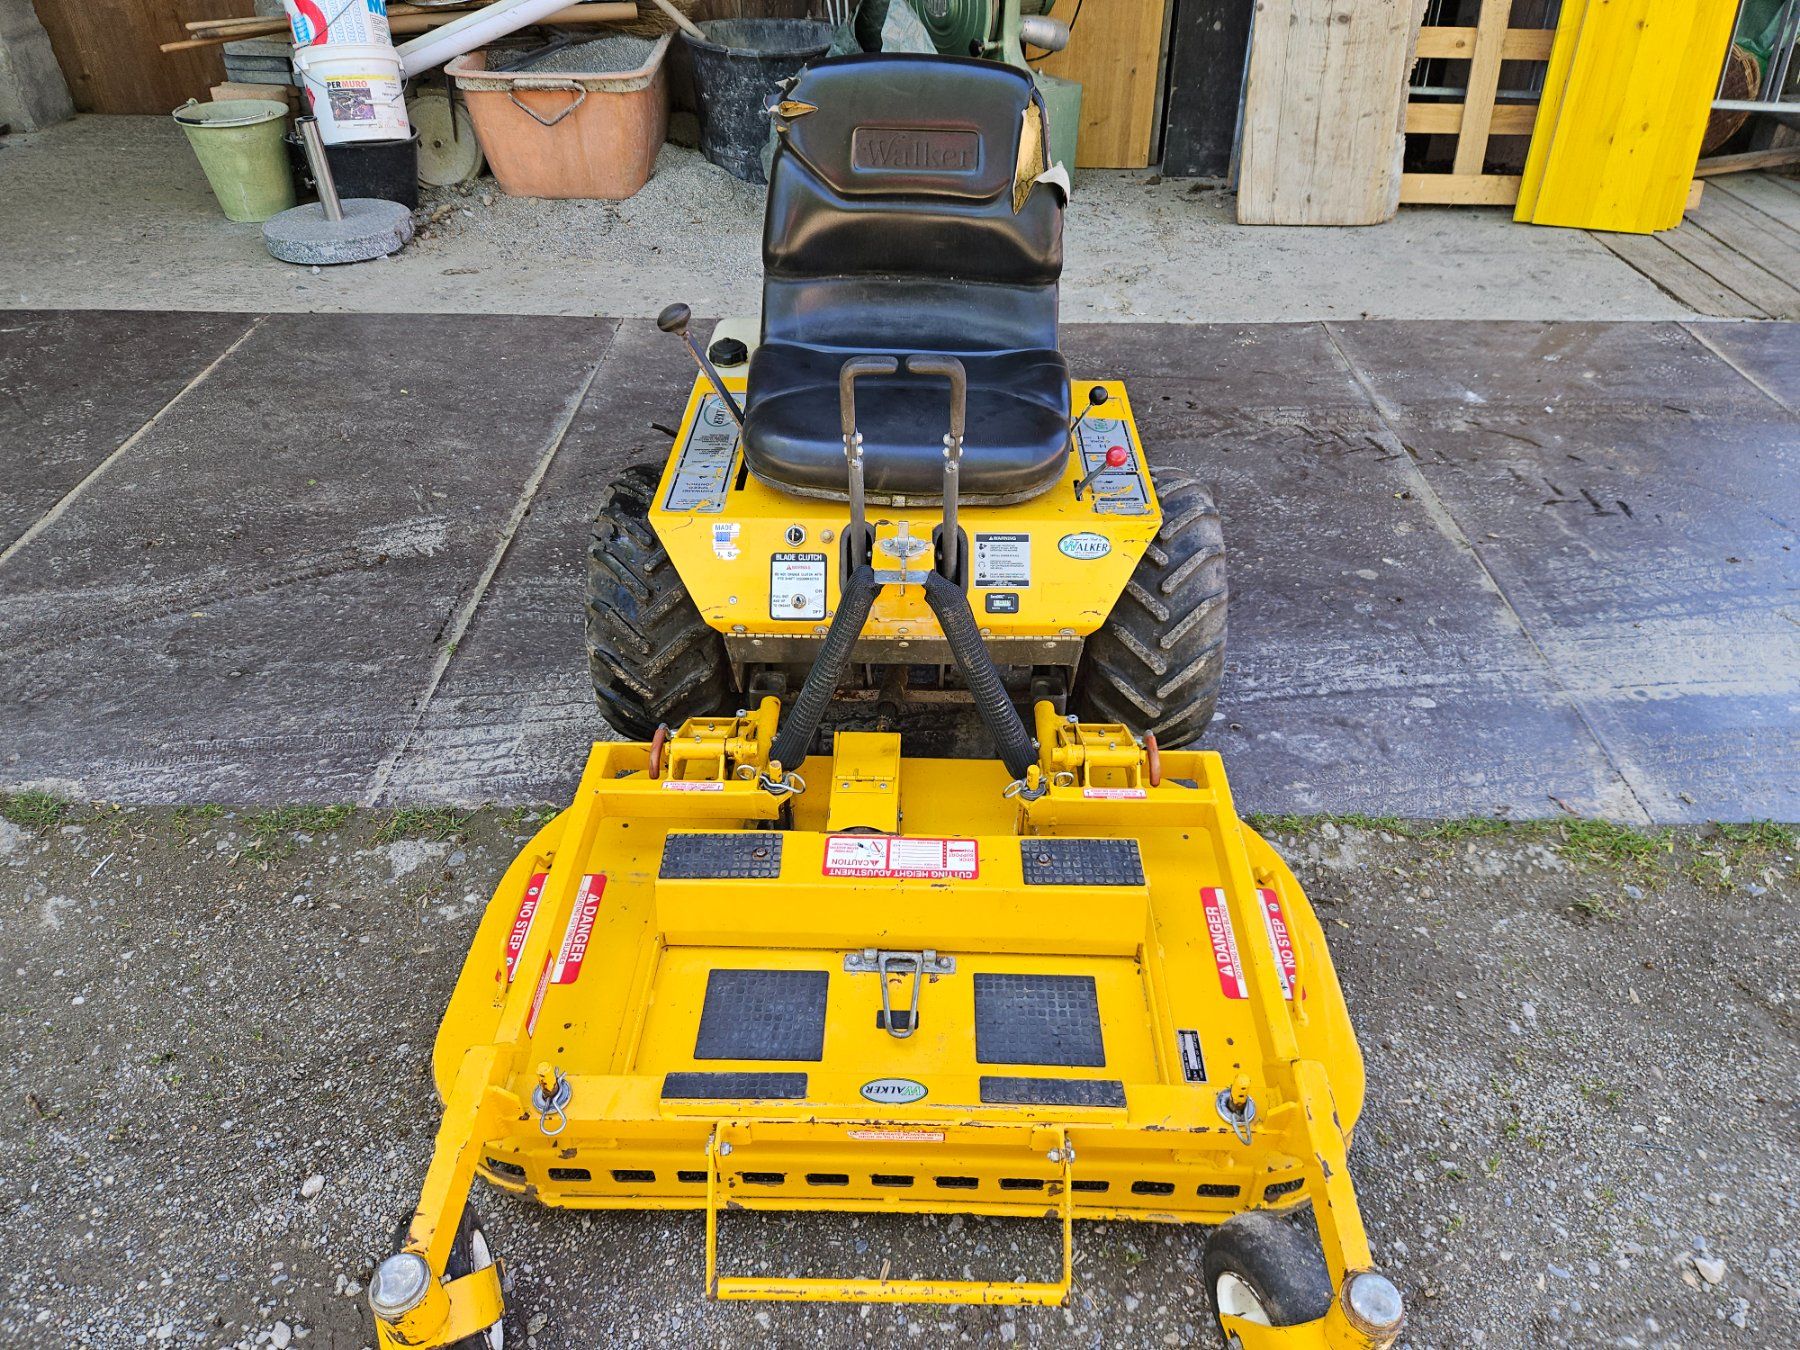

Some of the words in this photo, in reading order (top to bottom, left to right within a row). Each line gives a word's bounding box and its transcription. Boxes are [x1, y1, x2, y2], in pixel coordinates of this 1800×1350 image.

[326, 80, 368, 88] PERMURO
[865, 136, 972, 168] Walker
[1064, 541, 1108, 551] WALKER
[520, 902, 535, 917] NO
[1220, 904, 1230, 925] BLADES
[509, 921, 528, 949] STEP
[566, 917, 579, 941] CUTTING
[568, 906, 597, 962] DANGER
[1205, 907, 1231, 963] DANGER
[1226, 926, 1235, 950] CUTTING
[1272, 918, 1290, 947] STEP
[559, 942, 571, 964] BLADES
[1282, 950, 1295, 968] NO
[1231, 952, 1243, 980] ROTATING
[866, 1086, 921, 1096] WALKER
